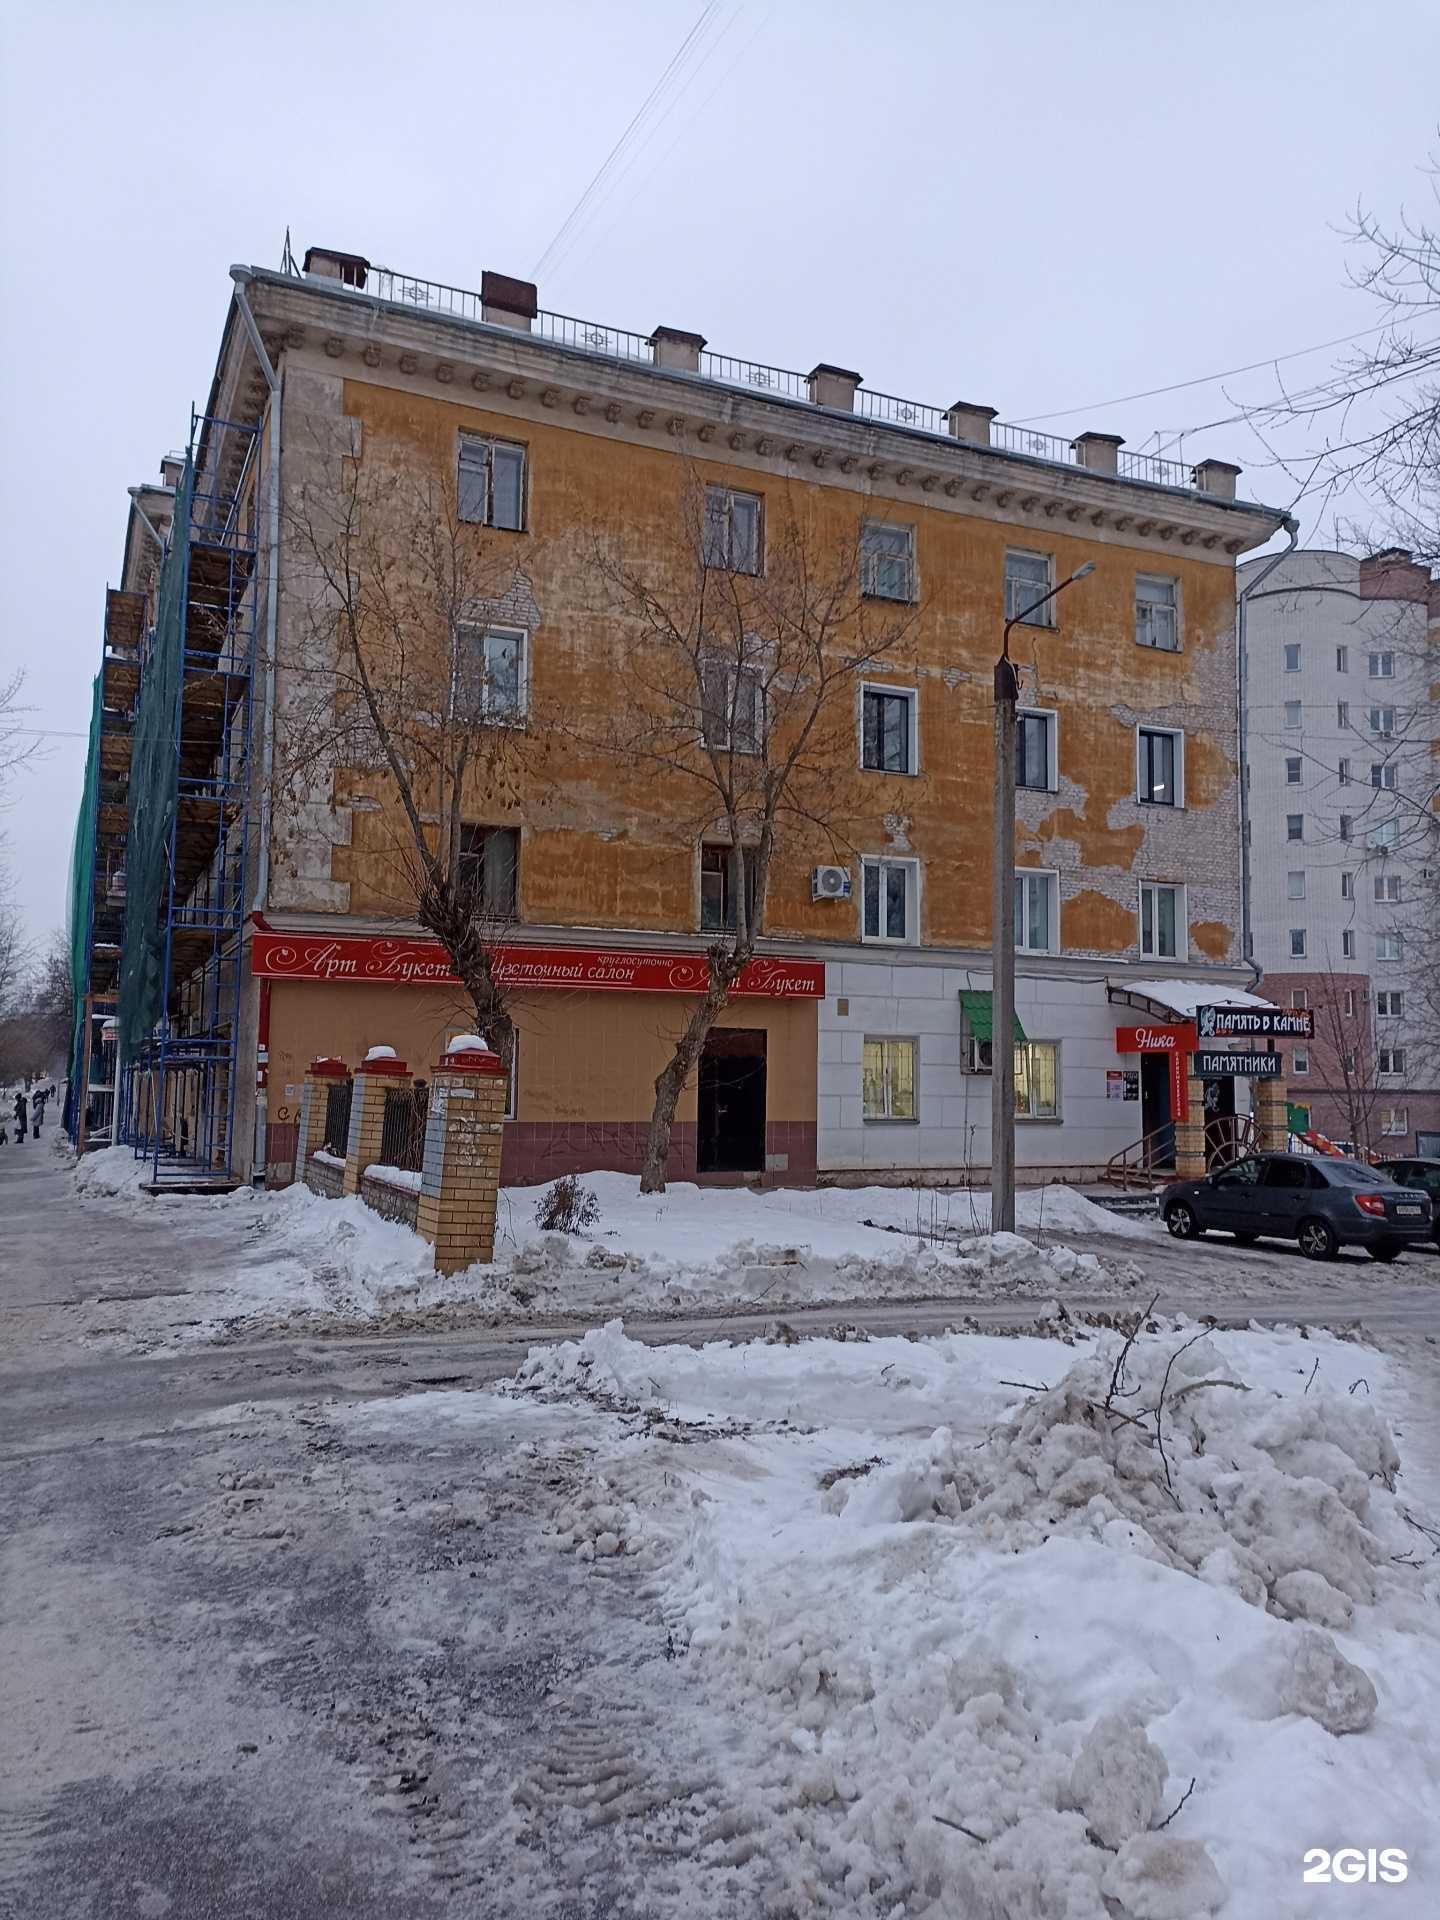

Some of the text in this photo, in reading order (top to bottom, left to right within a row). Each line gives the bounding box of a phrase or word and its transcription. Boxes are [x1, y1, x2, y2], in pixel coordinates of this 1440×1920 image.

[266, 941, 451, 981] Арт Букет
[597, 955, 674, 967] круглосуточно
[587, 965, 636, 980] салон
[748, 960, 815, 996] Букет
[1216, 1014, 1311, 1031] ПАМЯТЬ В КАМНЕ
[1135, 1028, 1176, 1048] Ника
[1203, 1055, 1276, 1073] ПАМЯТНИКИ
